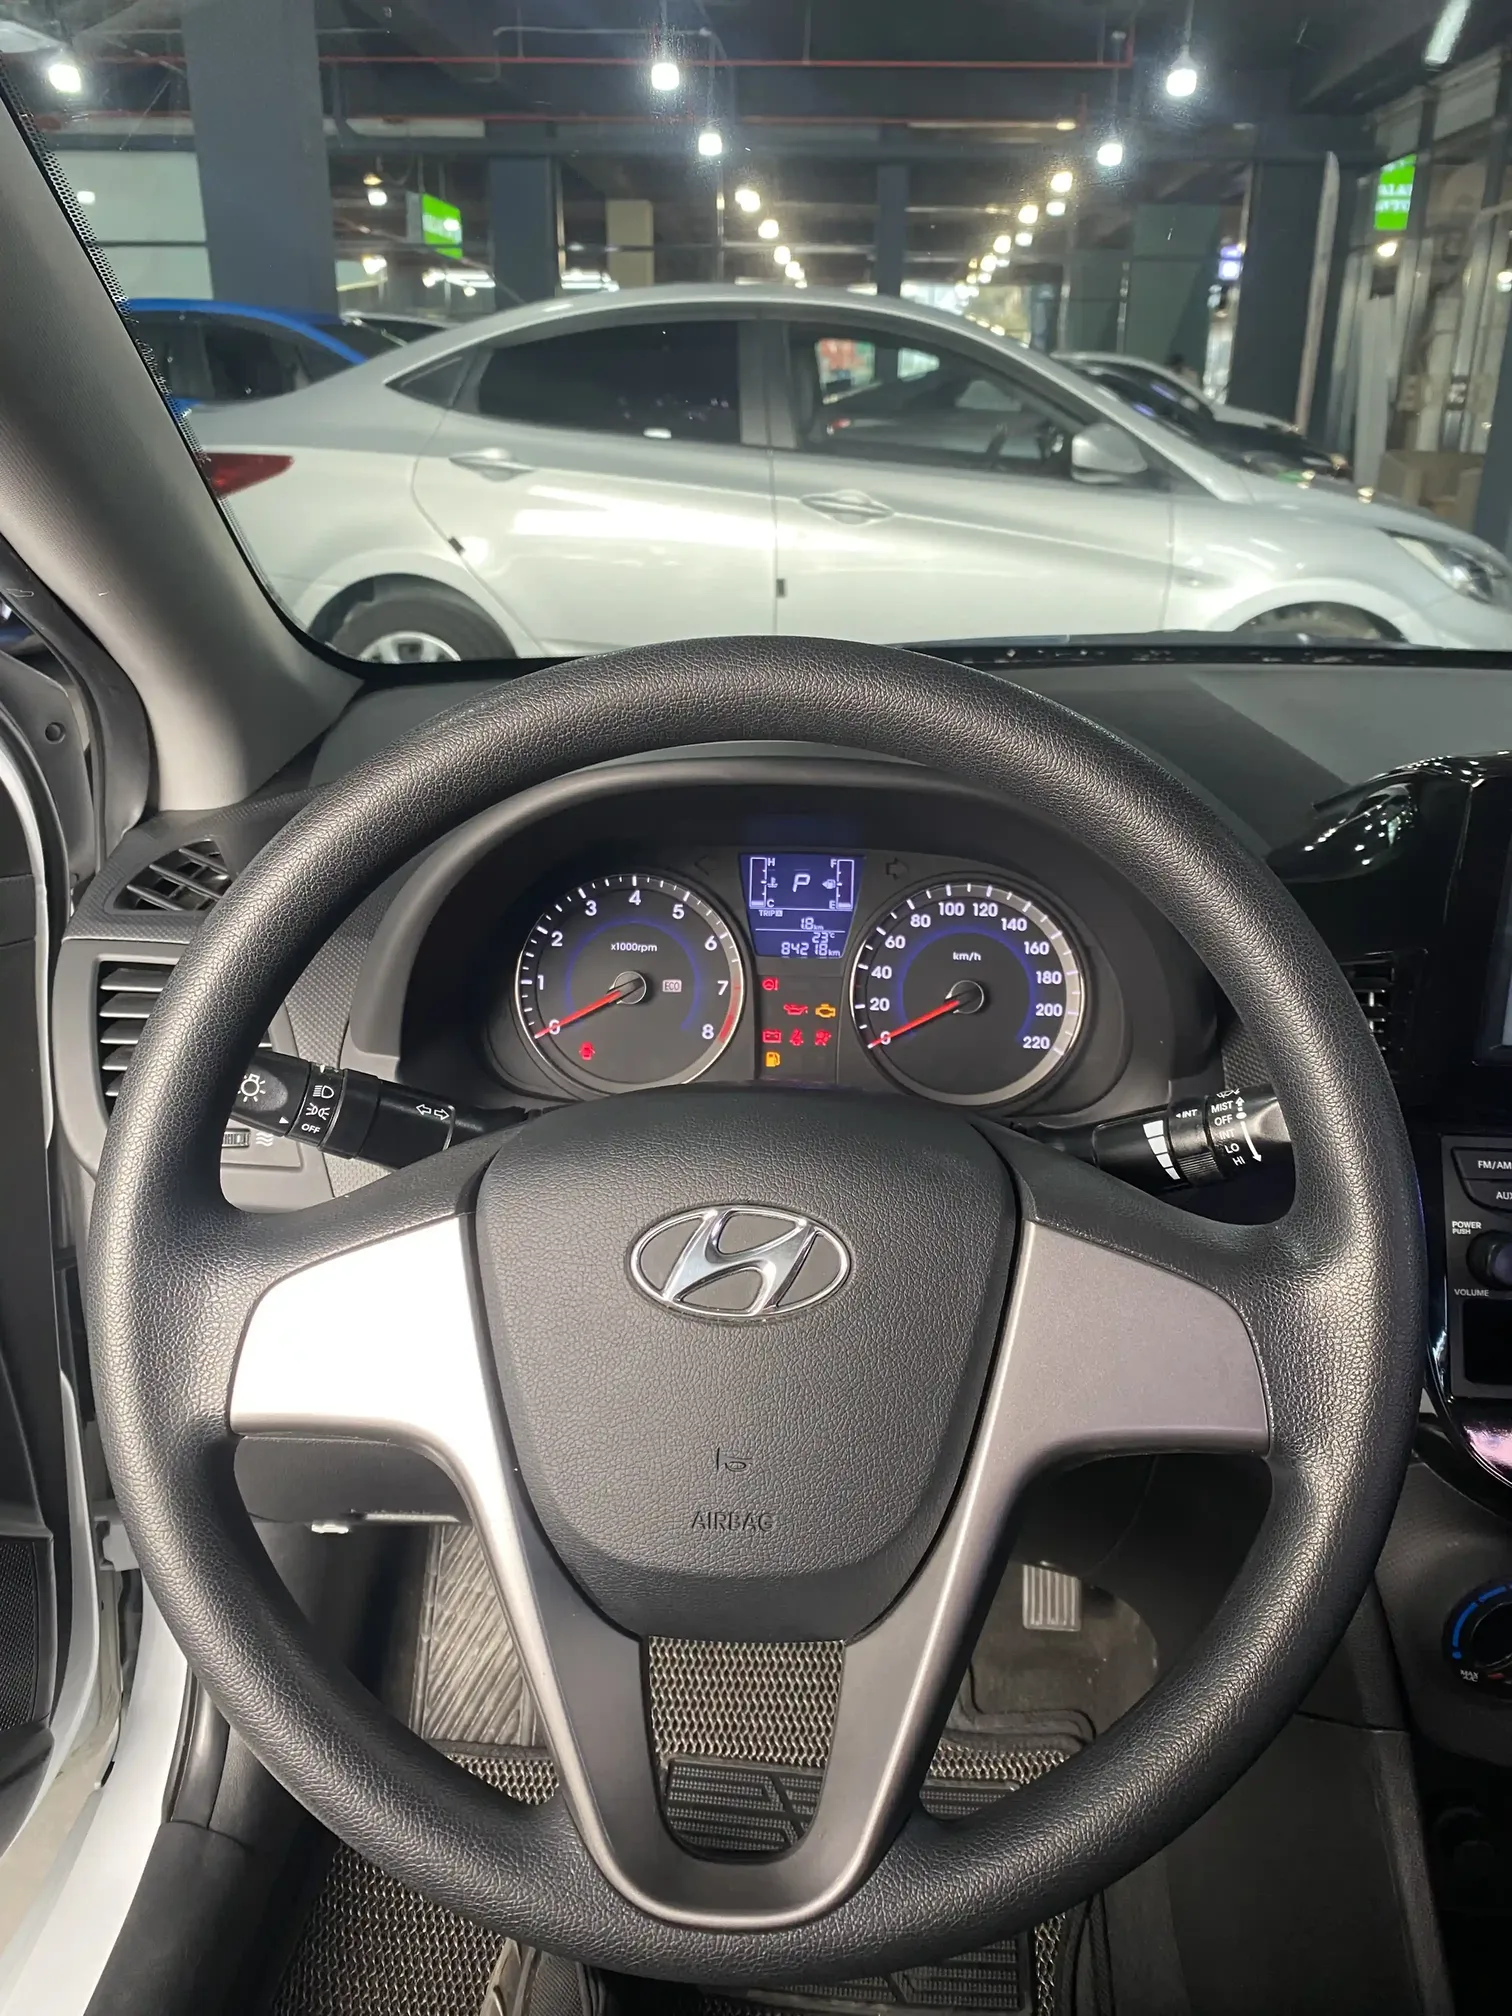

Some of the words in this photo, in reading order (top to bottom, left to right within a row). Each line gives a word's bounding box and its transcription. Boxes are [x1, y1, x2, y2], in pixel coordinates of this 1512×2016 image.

[767, 858, 776, 867] H
[830, 859, 837, 868] F
[792, 873, 811, 893] P
[629, 889, 642, 905] 4
[766, 899, 775, 908] C
[585, 900, 597, 916] 3
[672, 903, 685, 920] 5
[829, 900, 836, 909] E
[938, 902, 965, 917] 100
[972, 902, 998, 917] 120
[910, 914, 931, 929] 80
[1000, 918, 1027, 932] 140
[551, 931, 563, 947] 2
[704, 935, 718, 951] 6
[885, 935, 906, 949] 60
[610, 942, 658, 953] x1000rpm
[1024, 941, 1050, 956] 160
[952, 951, 982, 962] km/h
[871, 966, 892, 980] 40
[1036, 971, 1062, 985] 180
[537, 974, 545, 990] 1
[664, 982, 680, 991] ECO
[717, 980, 729, 995] 7
[870, 997, 890, 1011] 20
[1035, 1003, 1063, 1017] 200
[549, 1019, 561, 1035] 0
[702, 1023, 715, 1039] 8
[880, 1031, 892, 1045] 0
[1023, 1036, 1050, 1050] 220
[1181, 1109, 1198, 1119] INT
[1211, 1100, 1233, 1114] MIST
[1214, 1114, 1233, 1127] OFF
[301, 1123, 321, 1134] OFF
[1219, 1128, 1236, 1139] INT
[1225, 1143, 1239, 1154] LO
[1232, 1155, 1245, 1166] HI
[1477, 1160, 1512, 1170] FM/AM
[1451, 1220, 1482, 1229] POWER
[1454, 1288, 1489, 1297] VOLUME
[691, 1511, 775, 1532] AIRBAG
